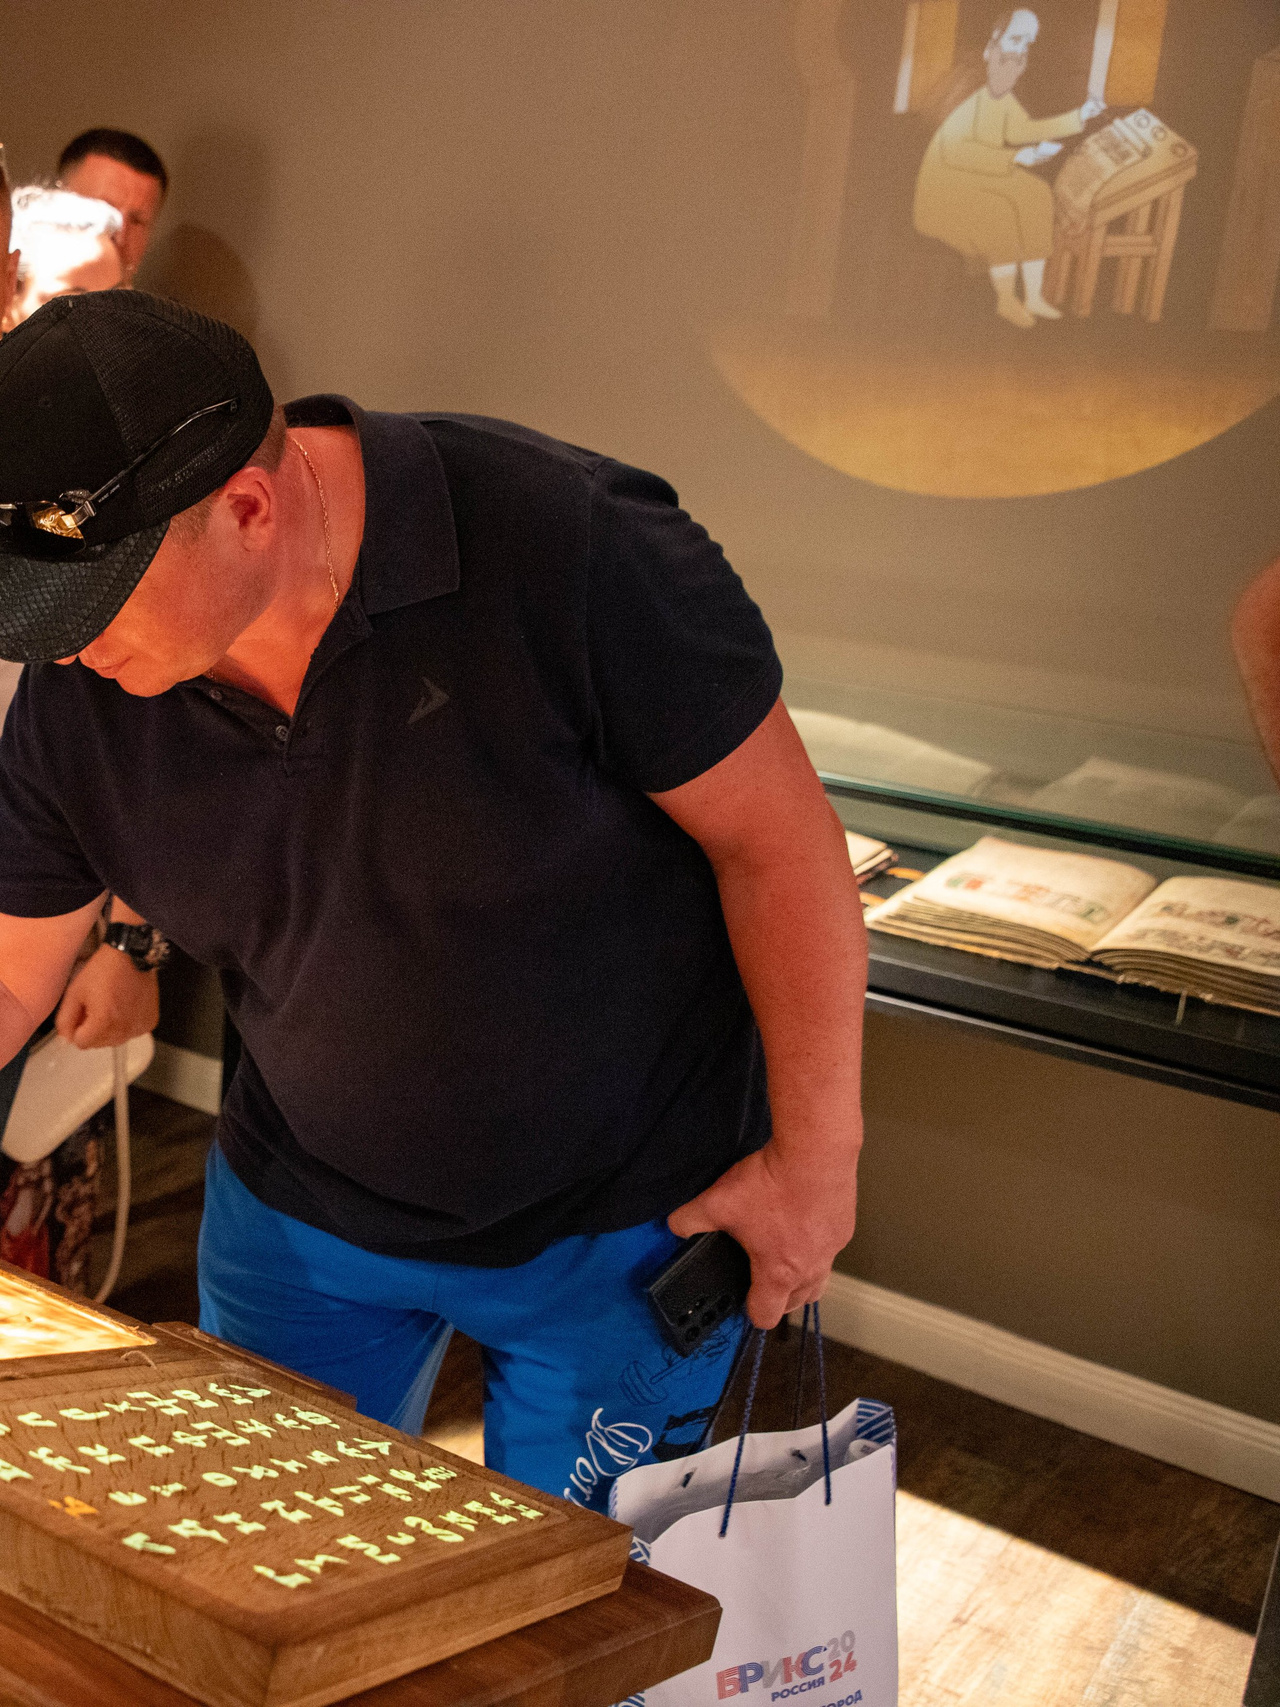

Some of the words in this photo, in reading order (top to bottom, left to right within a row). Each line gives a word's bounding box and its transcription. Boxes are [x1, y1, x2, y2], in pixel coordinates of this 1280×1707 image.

[716, 1645, 827, 1700] БРИКС
[827, 1630, 856, 1661] 20
[829, 1651, 858, 1683] 24
[771, 1676, 826, 1702] РОССИЯ
